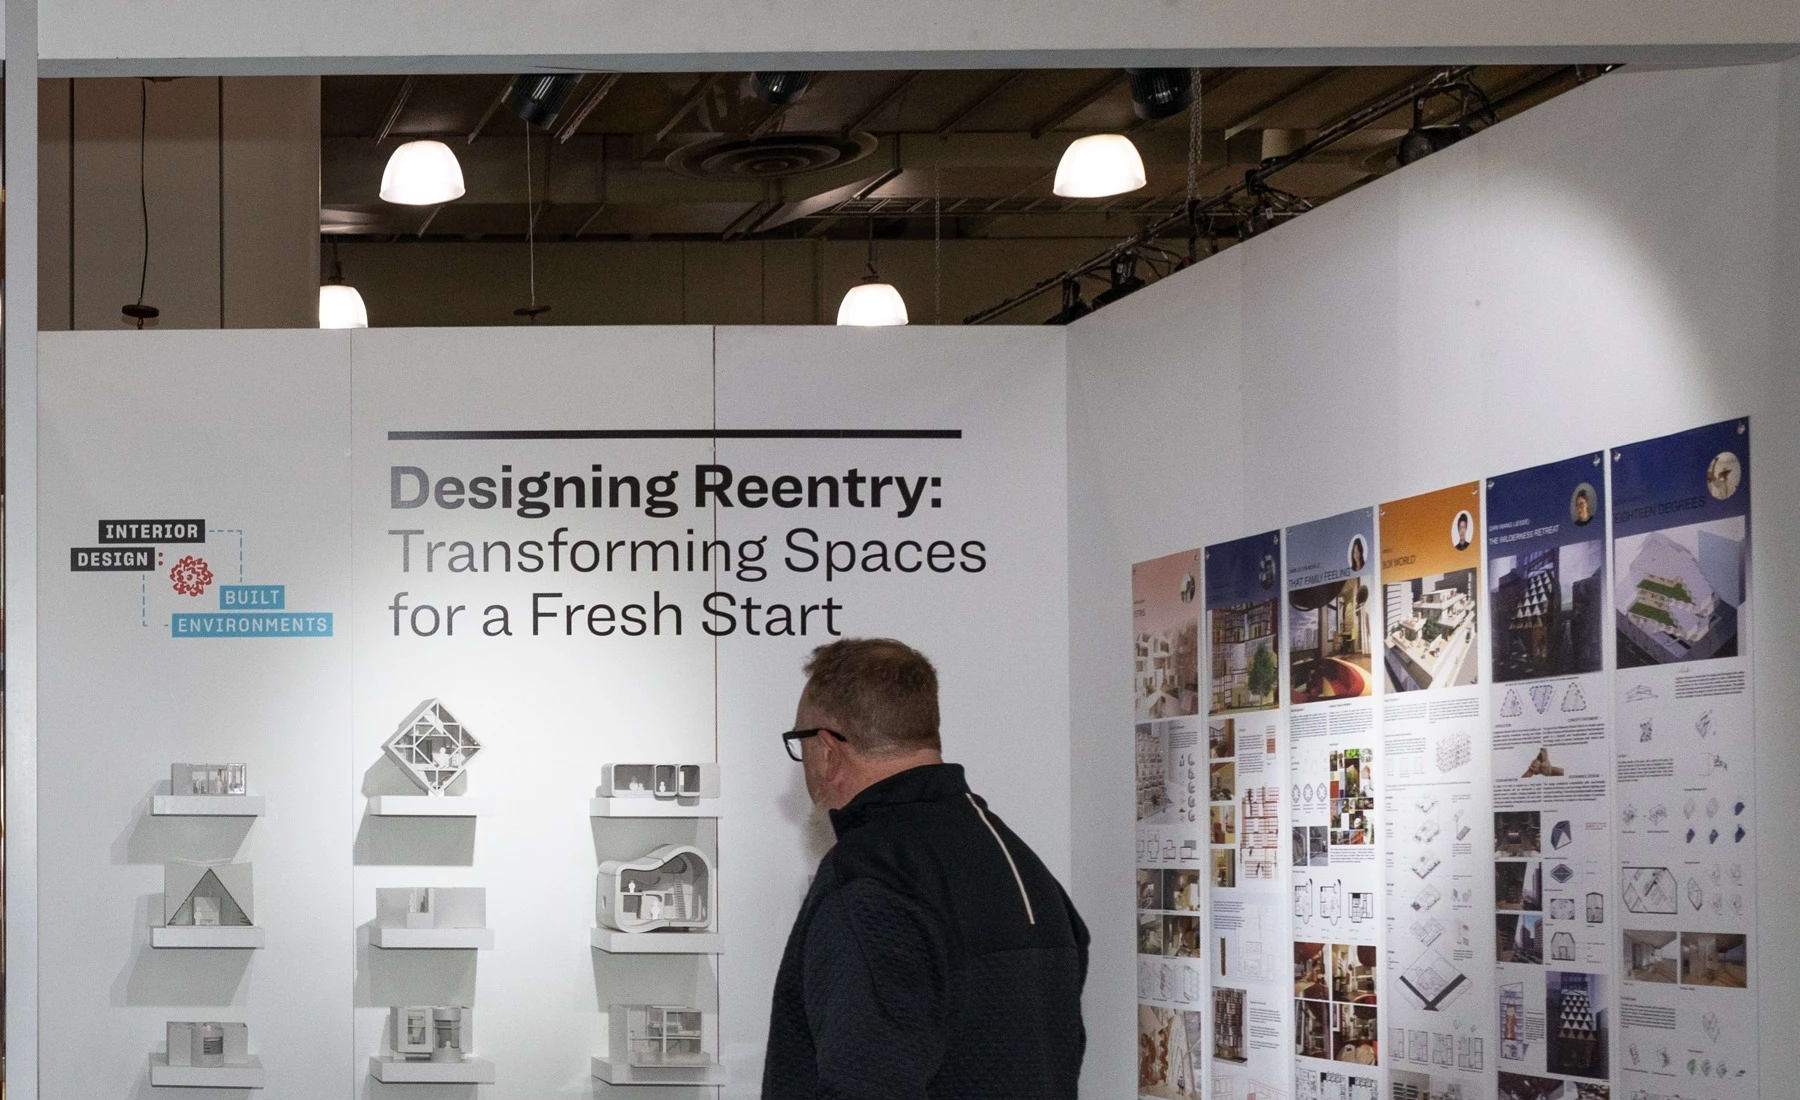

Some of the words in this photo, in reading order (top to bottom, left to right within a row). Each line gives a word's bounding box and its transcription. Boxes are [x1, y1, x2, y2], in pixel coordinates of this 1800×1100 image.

[389, 464, 679, 518] Designing
[694, 464, 943, 518] Reentry:
[105, 523, 198, 539] INTERIOR
[387, 526, 768, 582] Transforming
[784, 526, 987, 582] Spaces
[225, 590, 280, 605] BUILT
[178, 617, 327, 633] ENVIRONMENTS
[388, 592, 466, 637] for
[481, 604, 512, 637] a
[531, 590, 683, 637] Fresh
[702, 591, 843, 637] Start
